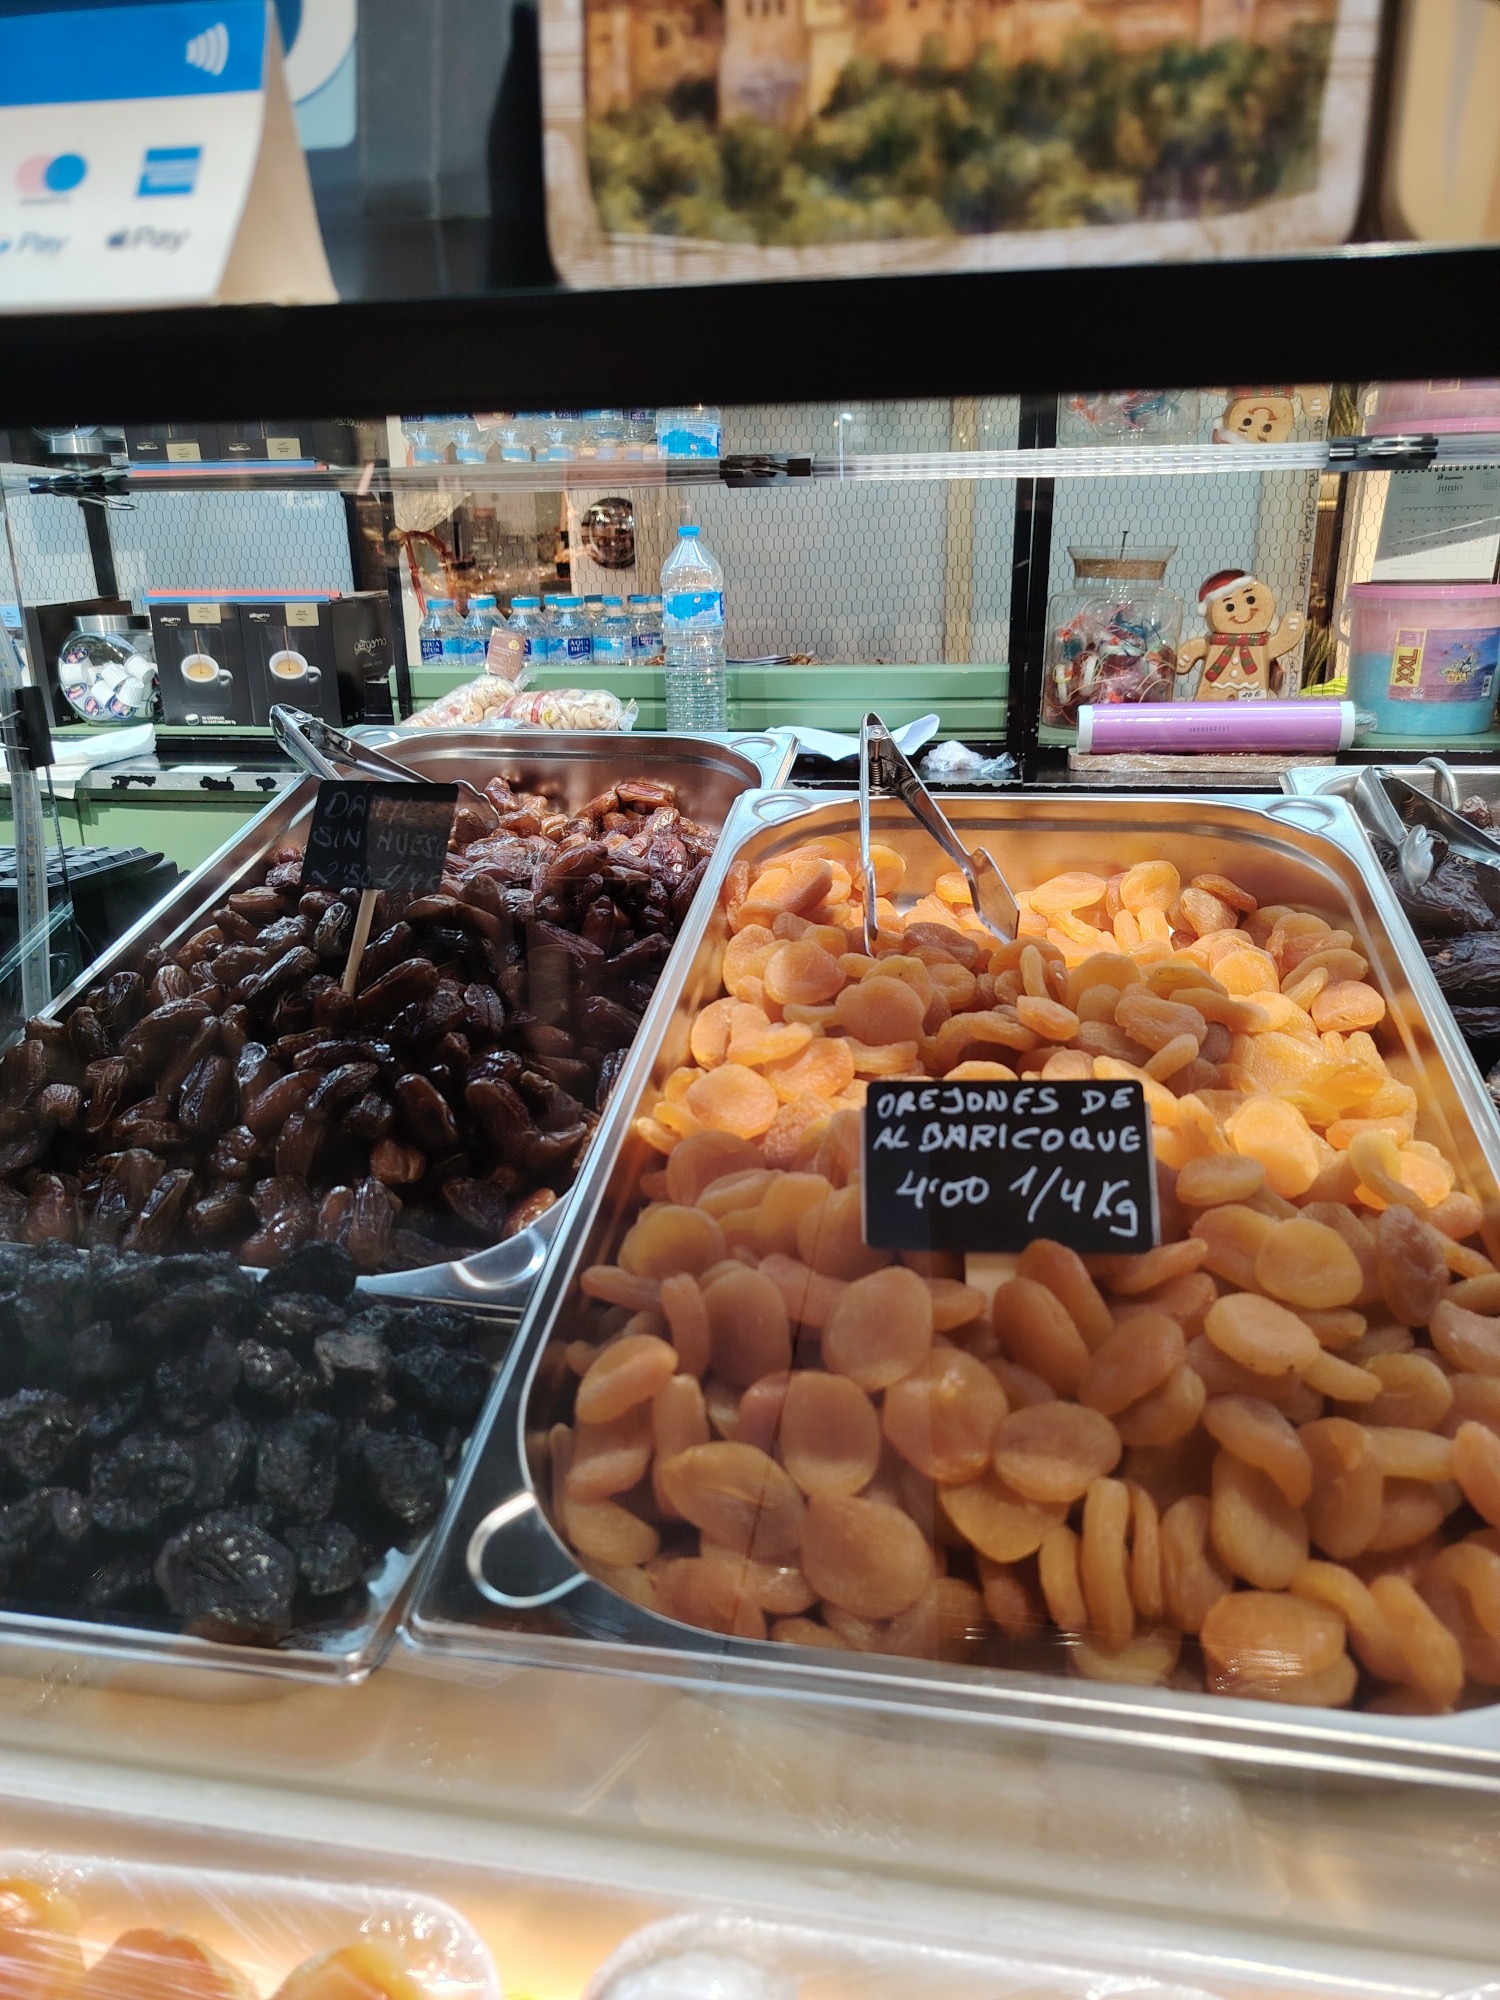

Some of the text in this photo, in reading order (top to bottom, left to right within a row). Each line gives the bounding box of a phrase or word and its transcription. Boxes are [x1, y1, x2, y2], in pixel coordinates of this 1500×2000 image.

[1435, 482, 1463, 494] junio
[1394, 648, 1419, 685] XXL
[312, 825, 363, 850] SIN
[876, 1086, 1136, 1119] OREJONES DE
[895, 1165, 1139, 1239] 4'00 1/4 Kg
